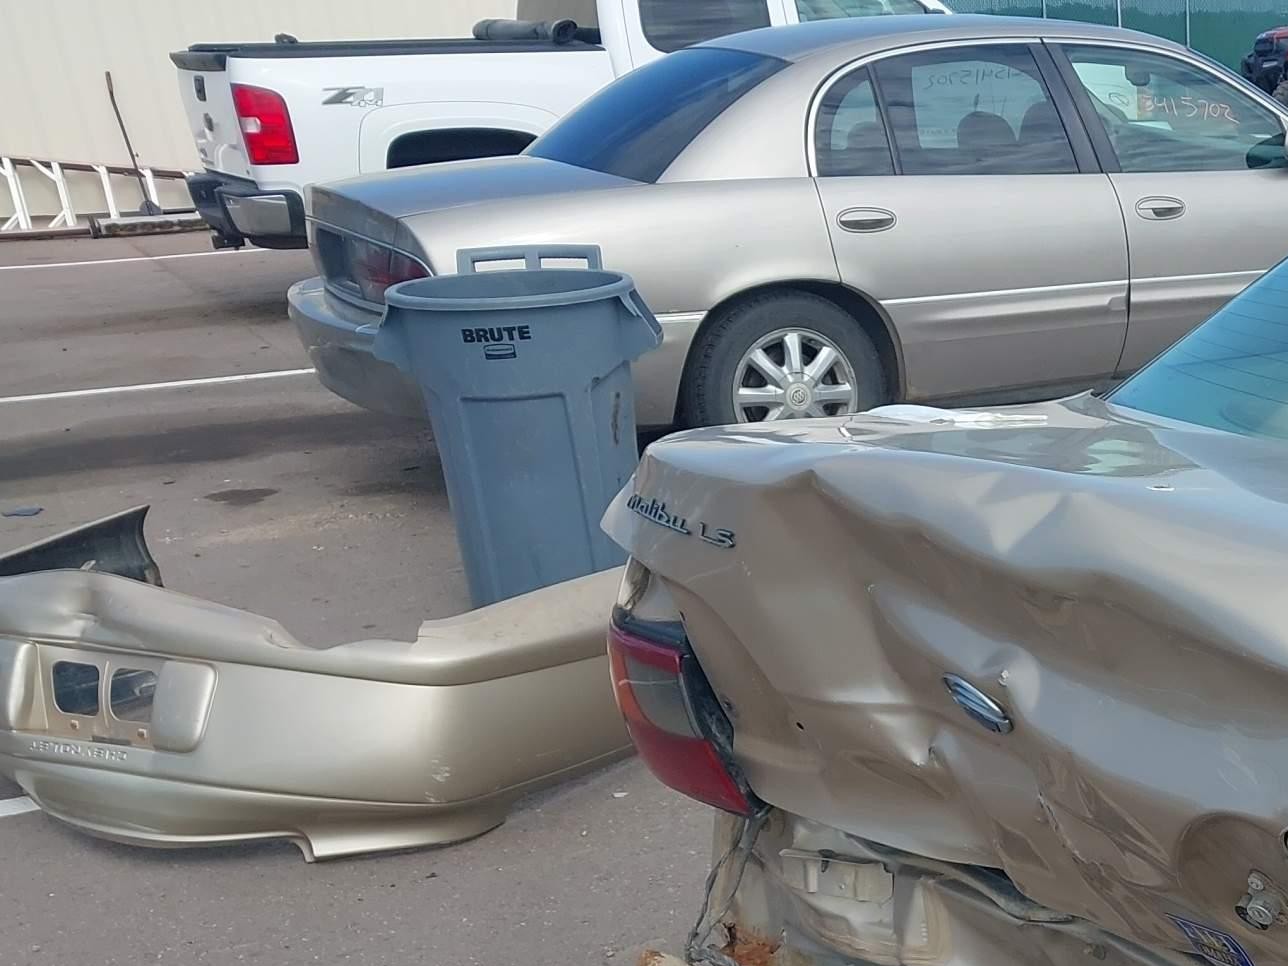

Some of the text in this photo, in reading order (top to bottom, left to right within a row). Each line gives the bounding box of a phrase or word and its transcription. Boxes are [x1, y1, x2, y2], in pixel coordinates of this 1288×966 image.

[461, 325, 532, 344] BRUTE
[626, 494, 737, 549] Malibu LS
[29, 740, 128, 761] CHEVROLET
